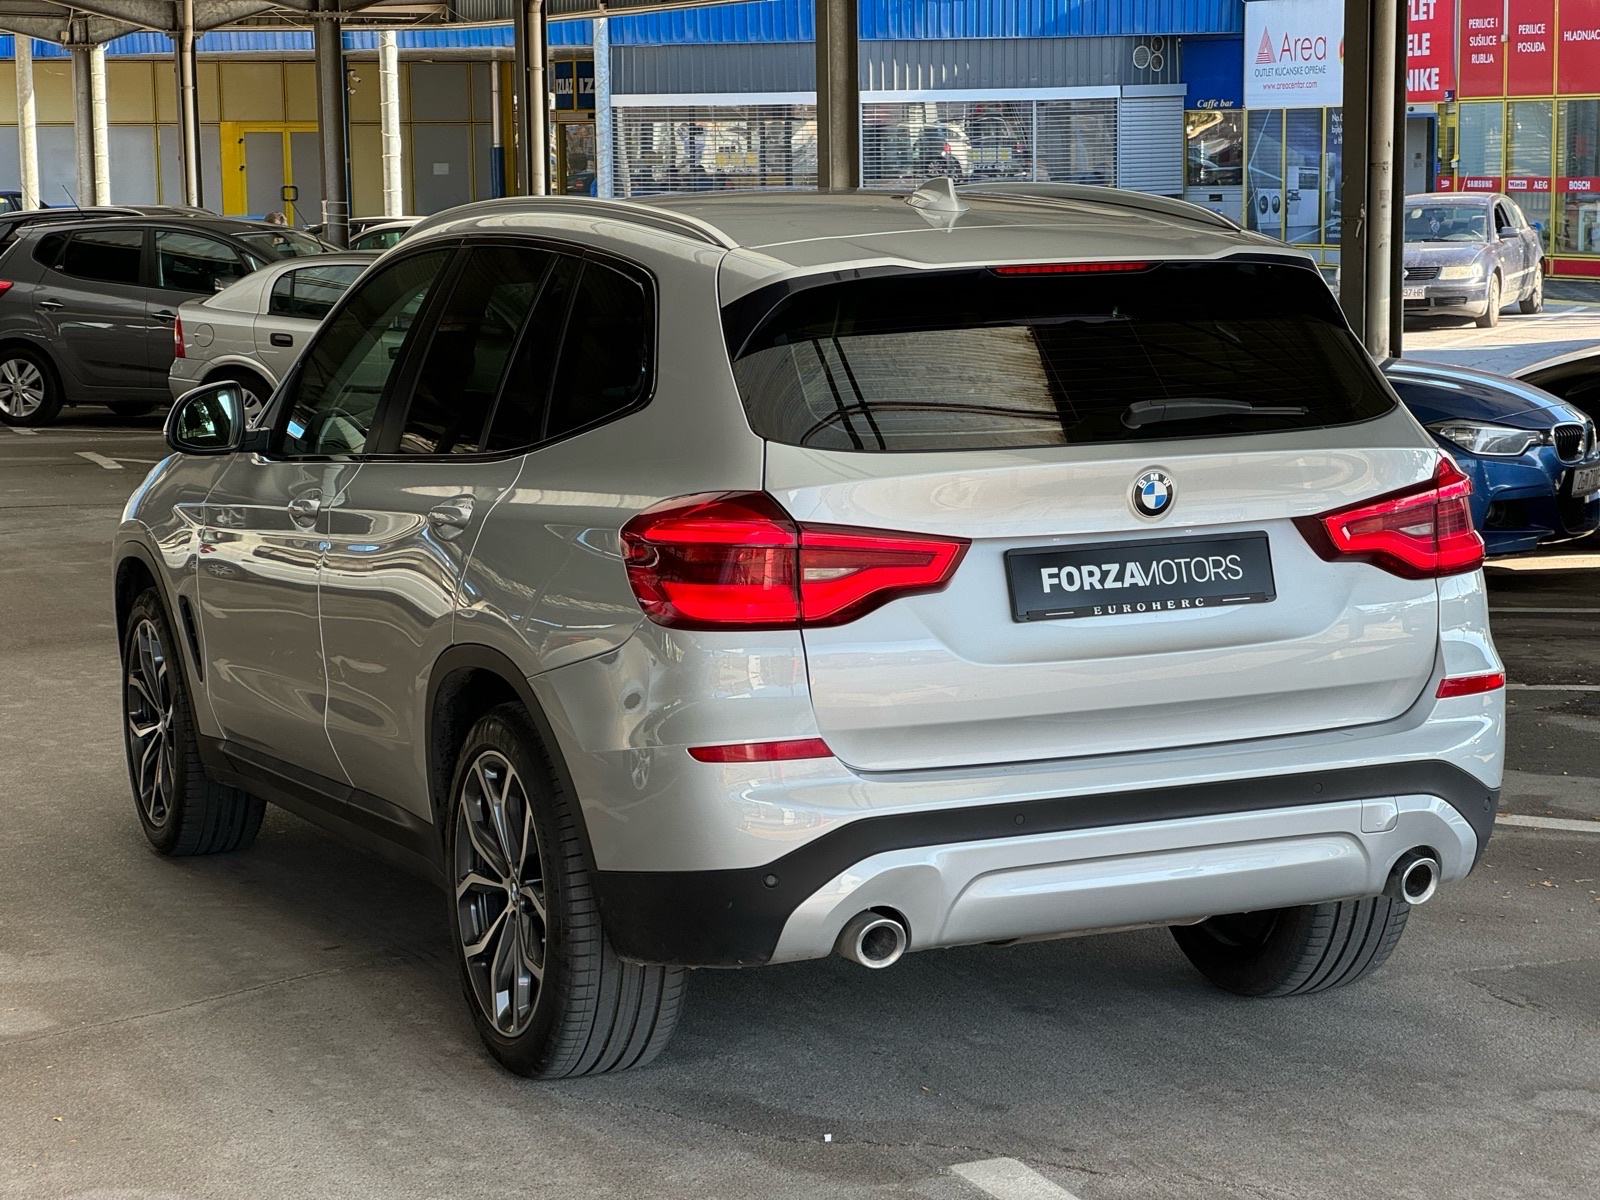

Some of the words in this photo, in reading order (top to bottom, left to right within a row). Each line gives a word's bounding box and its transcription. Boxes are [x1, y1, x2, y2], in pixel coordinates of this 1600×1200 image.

[1469, 18, 1495, 29] PERILICE
[1518, 23, 1546, 35] PERILICE
[1469, 35, 1497, 47] SUŠILICE
[1279, 32, 1327, 62] Area
[1471, 53, 1494, 64] RUBLJA
[1254, 67, 1274, 78] OUTLET
[1304, 65, 1327, 75] OPREME
[1197, 99, 1218, 109] Caffe
[1220, 99, 1234, 108] bar
[1467, 180, 1493, 188] SAMSUNG
[1509, 180, 1527, 188] Miele
[1533, 180, 1548, 189] AEG
[1569, 180, 1590, 190] BOSCH
[1093, 597, 1205, 615] EUROHERC
